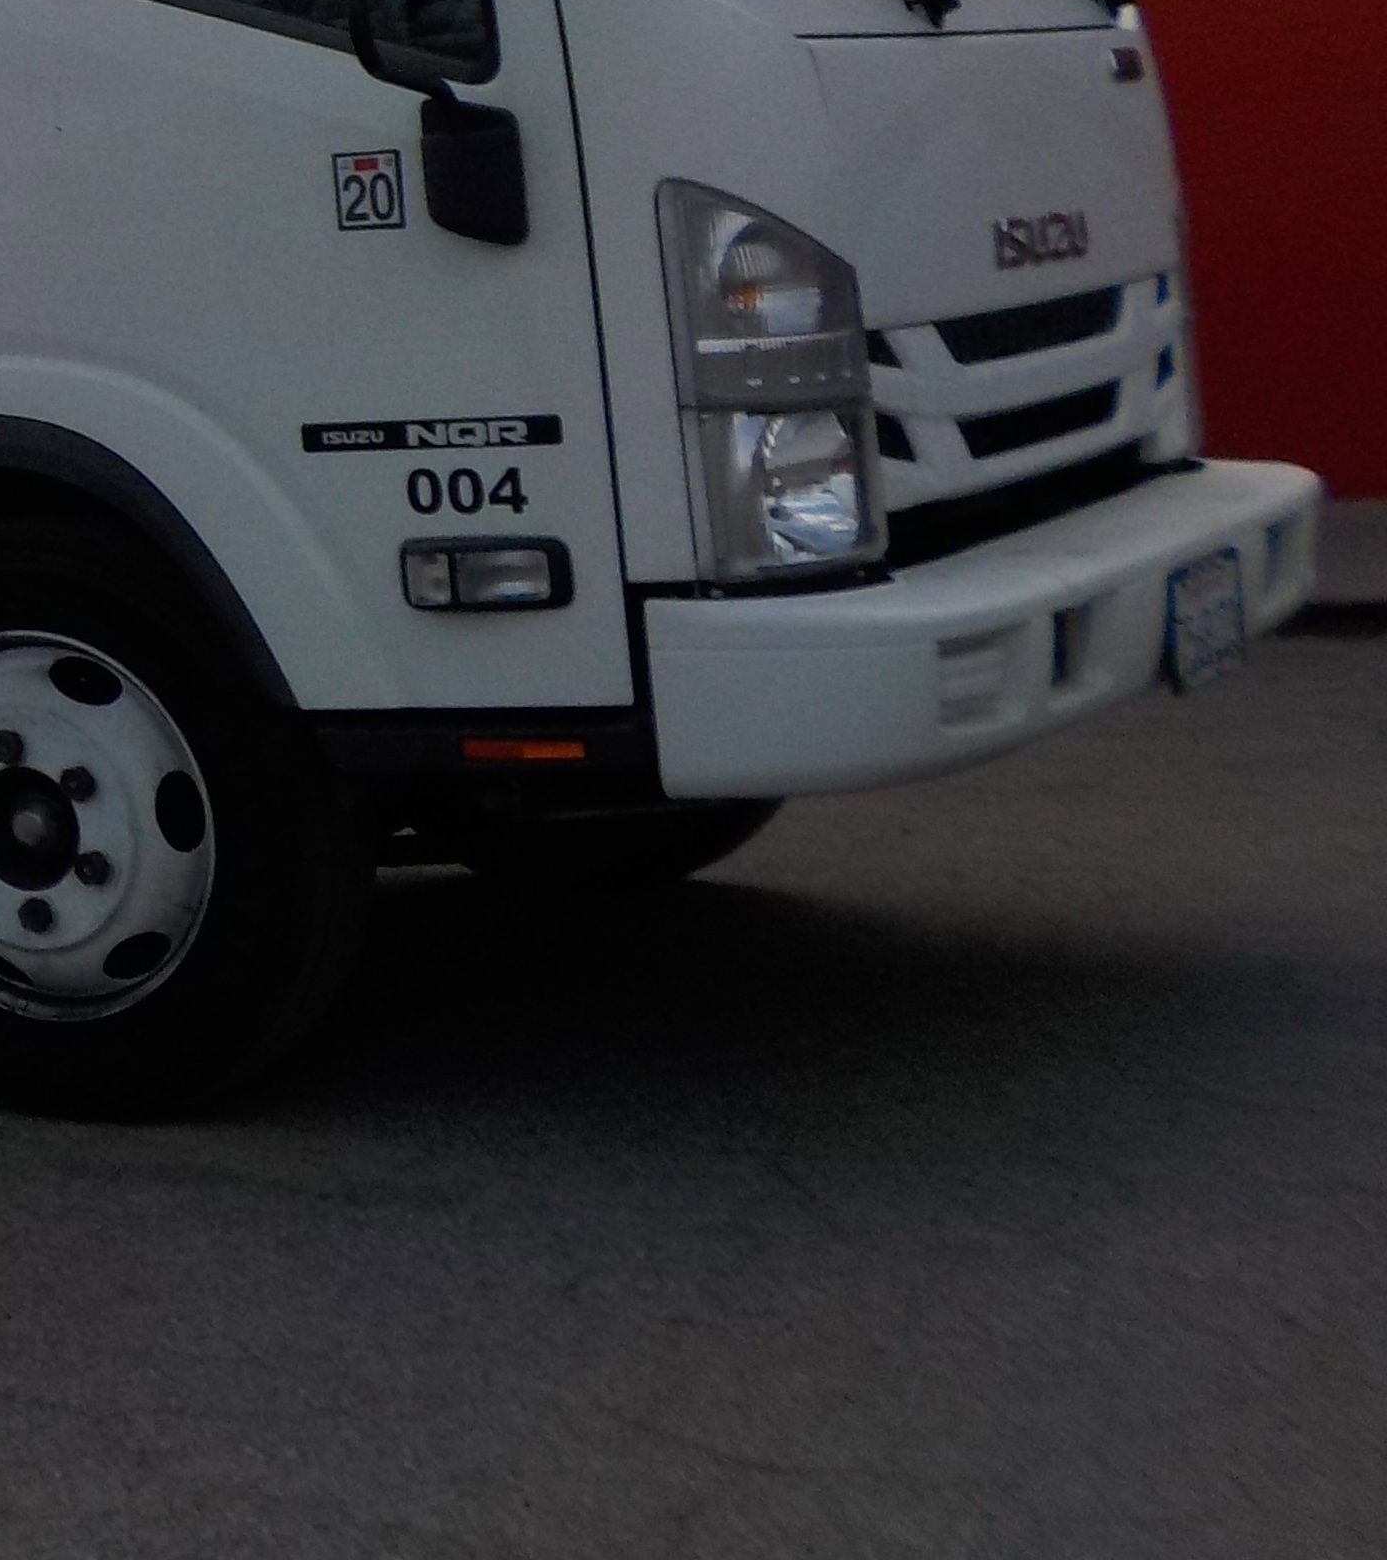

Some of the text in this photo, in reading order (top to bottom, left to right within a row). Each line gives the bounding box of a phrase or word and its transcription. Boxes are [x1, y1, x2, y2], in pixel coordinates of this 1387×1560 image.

[343, 172, 395, 221] 20
[992, 210, 1088, 269] ISUZU
[322, 420, 528, 447] ISUZU NQR
[408, 467, 528, 514] 004
